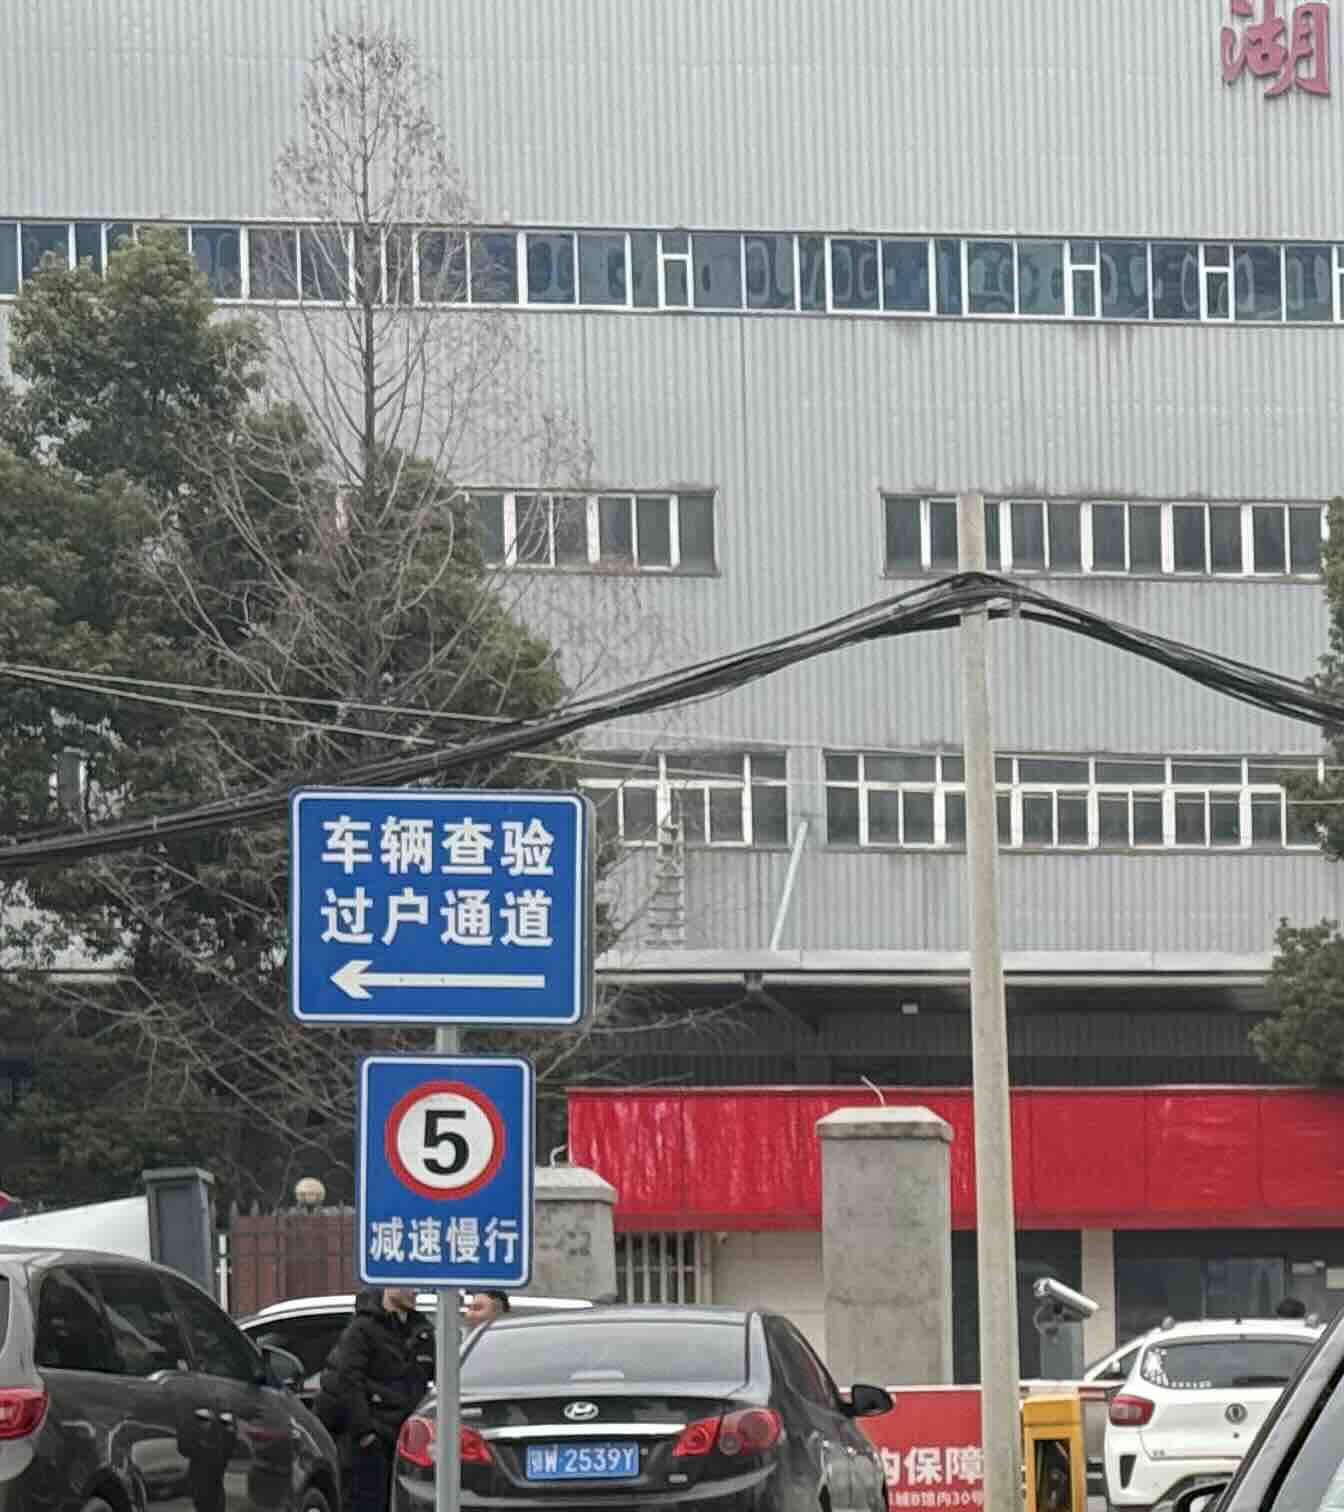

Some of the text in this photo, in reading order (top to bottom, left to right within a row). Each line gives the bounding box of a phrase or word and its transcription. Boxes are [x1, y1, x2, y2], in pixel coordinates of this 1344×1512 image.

[320, 815, 555, 877] 车辆查验
[320, 887, 553, 947] 过户通道
[422, 1108, 470, 1176] 5
[368, 1216, 520, 1265] 减速慢行
